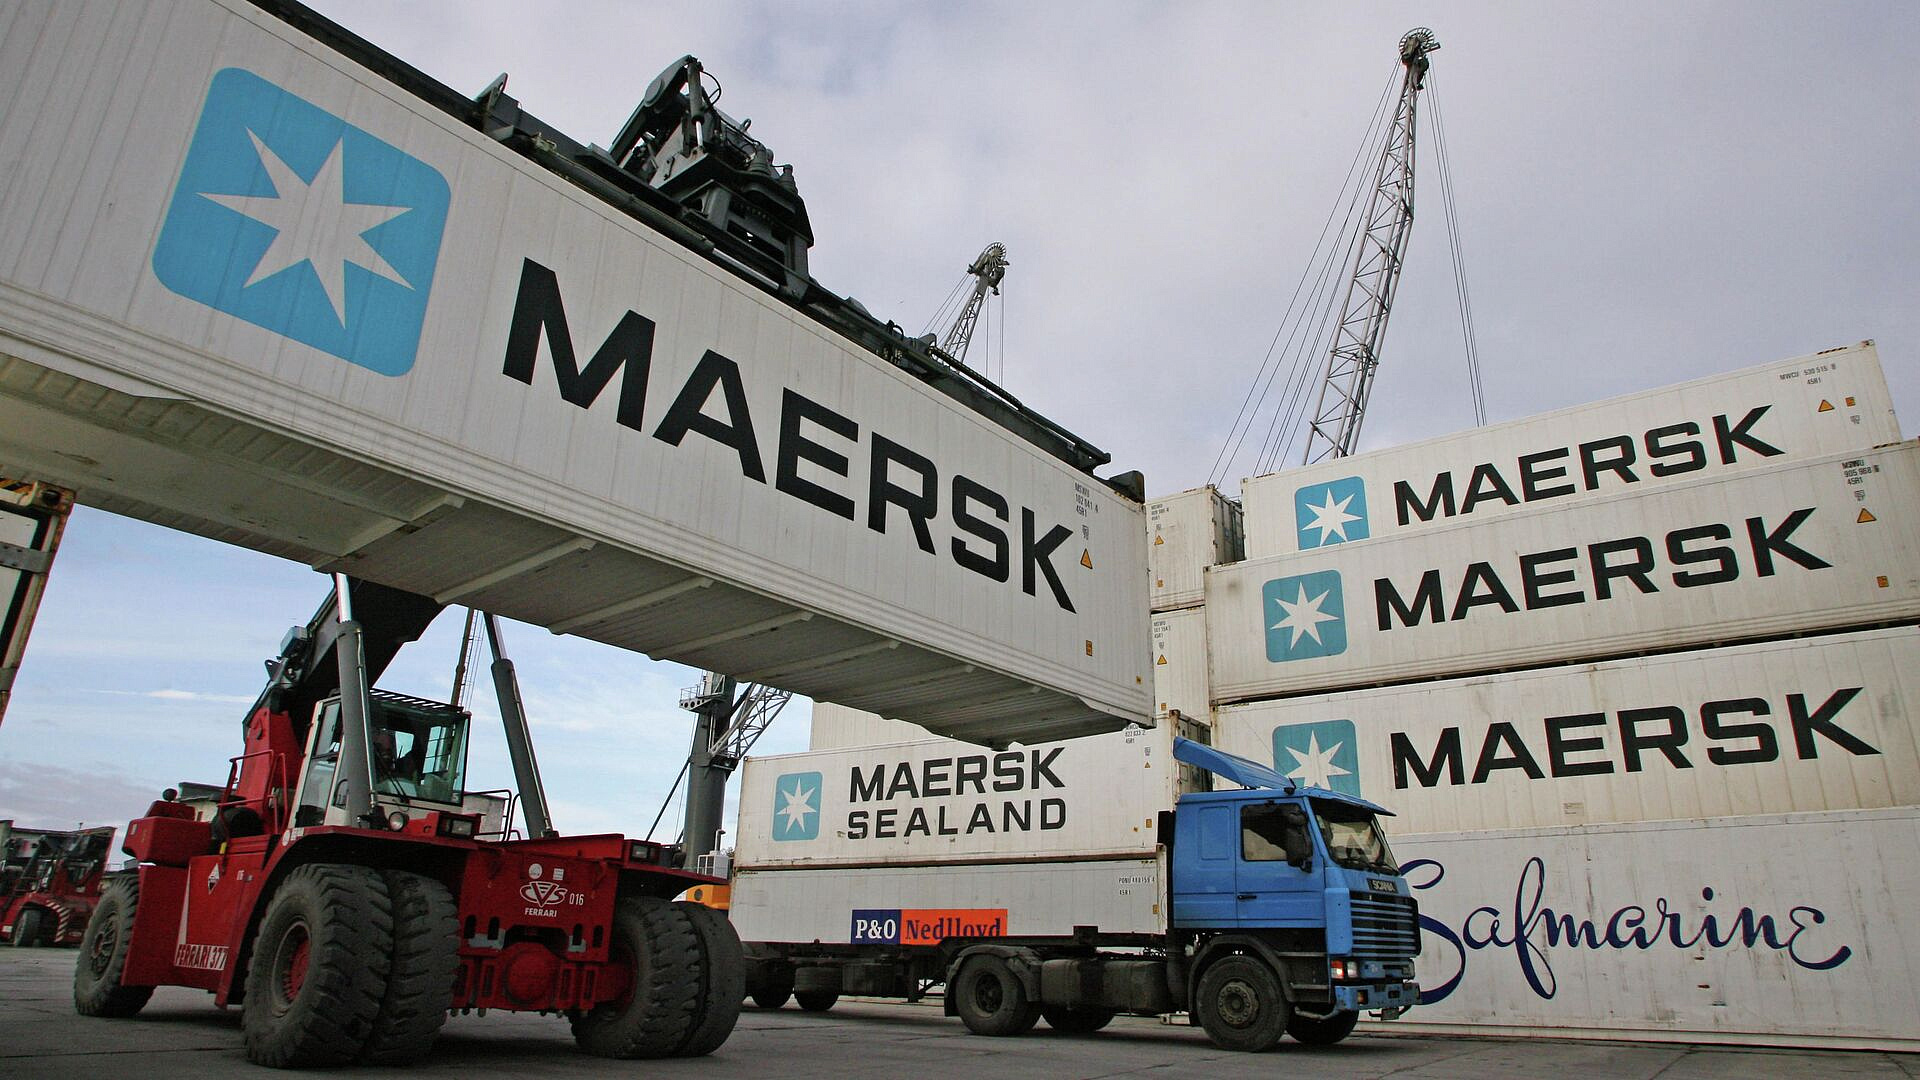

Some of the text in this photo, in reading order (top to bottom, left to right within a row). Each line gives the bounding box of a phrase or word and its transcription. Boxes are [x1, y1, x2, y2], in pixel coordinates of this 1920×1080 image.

[503, 257, 1077, 614] MAERSK
[1393, 404, 1785, 527] MAERSK
[1374, 507, 1833, 632] MAERSK
[1390, 687, 1883, 790] MAERSK
[849, 746, 1066, 803] MAERSK
[847, 797, 1067, 840] SEALAND
[524, 907, 558, 918] FERRARI
[568, 892, 585, 906] 016
[855, 917, 1001, 940] P&O Nedlloyd
